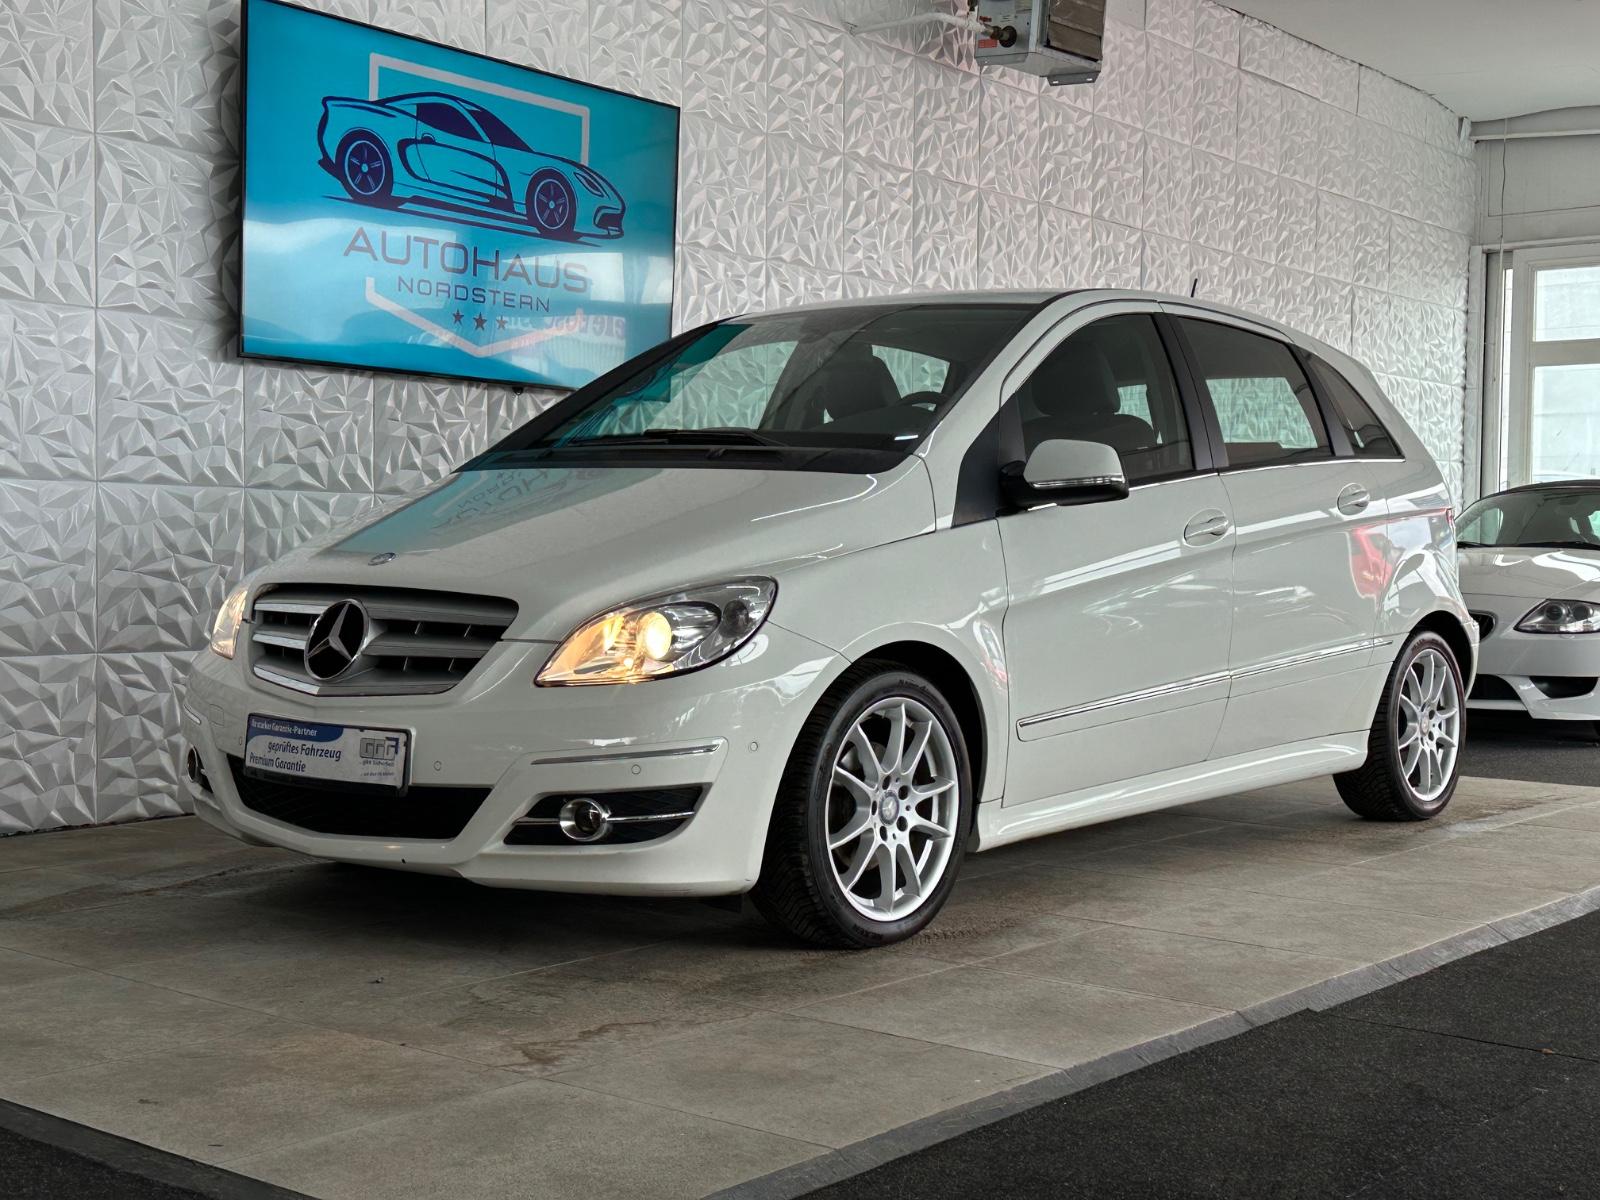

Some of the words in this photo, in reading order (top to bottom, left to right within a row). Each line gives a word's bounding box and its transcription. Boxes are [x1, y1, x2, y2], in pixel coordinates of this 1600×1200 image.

[343, 226, 588, 293] AUTOHAUS
[397, 275, 550, 312] NORDSTERN
[249, 752, 274, 768] Premium
[275, 757, 306, 773] Garantie
[267, 740, 299, 755] geprüftes
[300, 744, 342, 761] Fahrzeug
